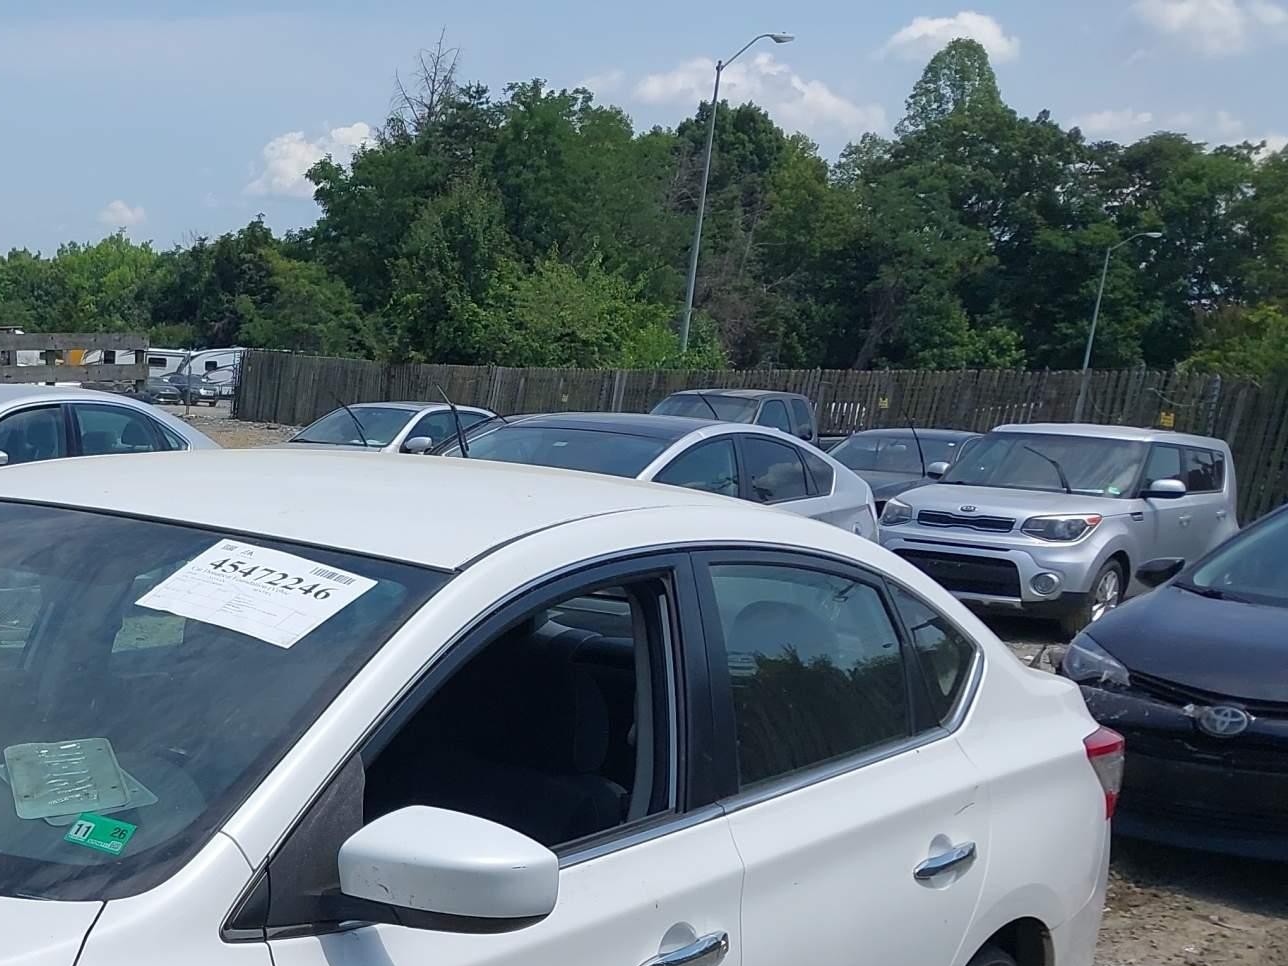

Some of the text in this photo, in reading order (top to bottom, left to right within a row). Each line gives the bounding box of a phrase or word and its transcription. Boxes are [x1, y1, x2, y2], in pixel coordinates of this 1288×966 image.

[209, 557, 337, 600] 45472246
[73, 823, 92, 838] 11
[110, 827, 129, 840] 26
